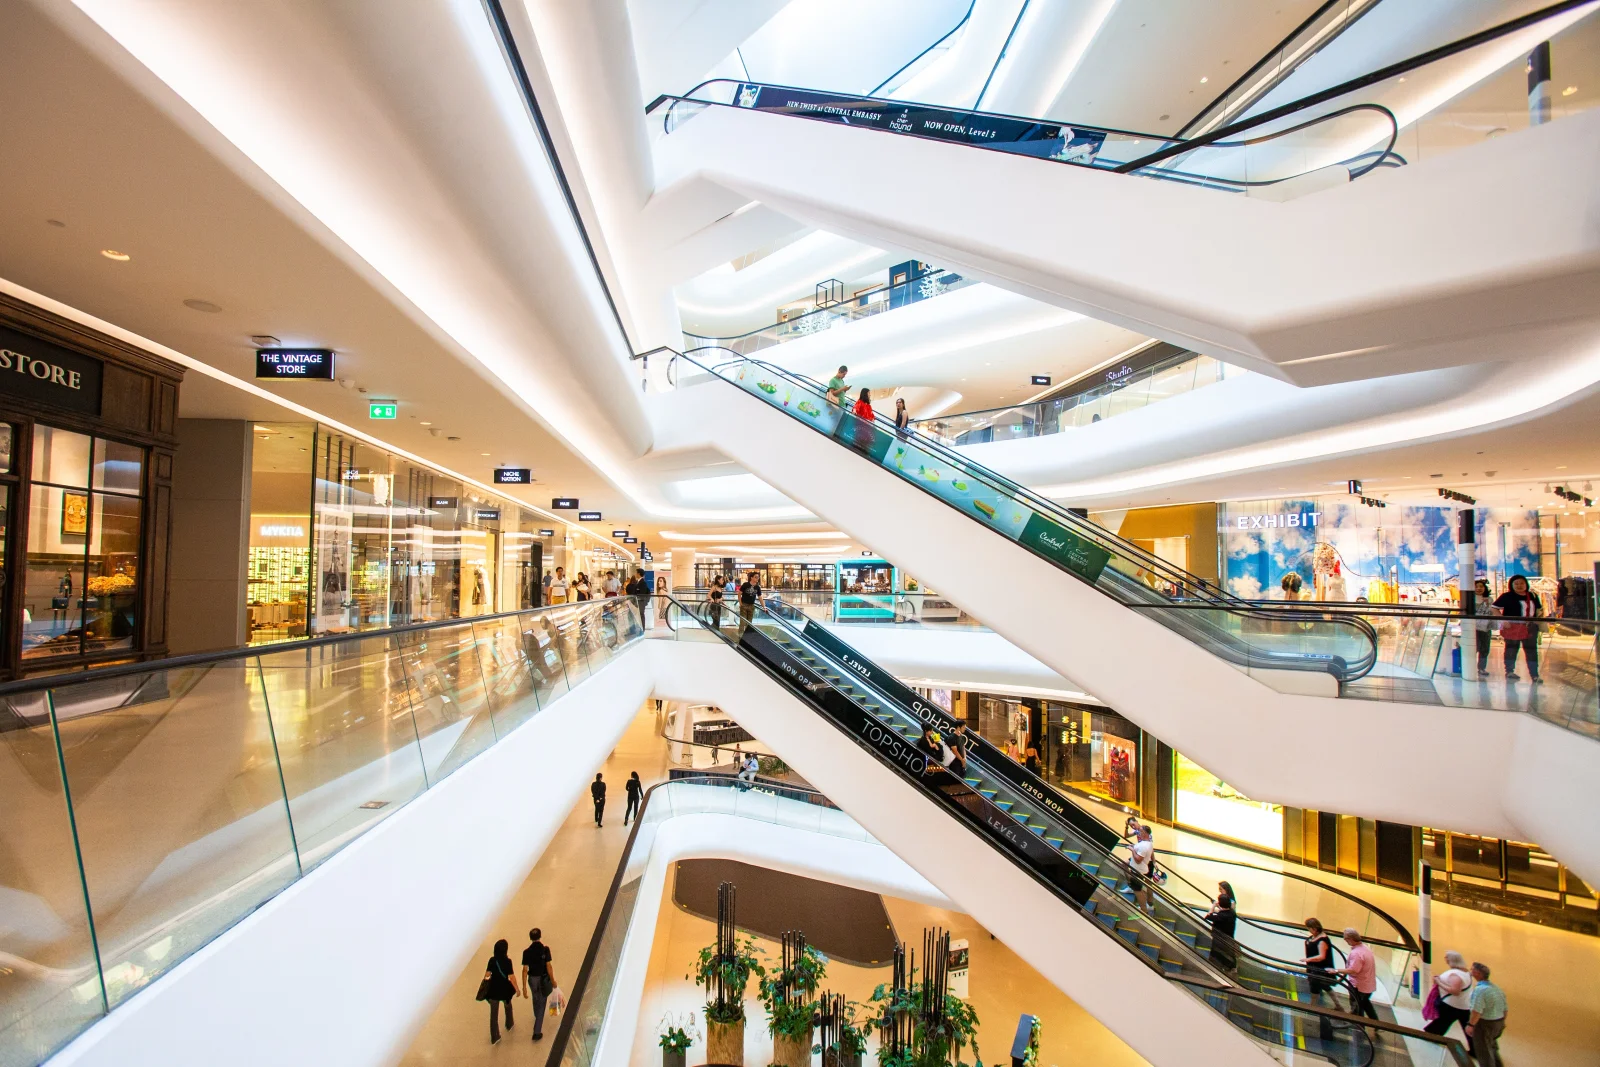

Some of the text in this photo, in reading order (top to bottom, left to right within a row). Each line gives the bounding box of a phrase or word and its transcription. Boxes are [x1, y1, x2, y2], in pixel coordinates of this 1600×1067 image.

[800, 102, 817, 111] TWIST
[824, 106, 851, 116] CENTRAL
[851, 110, 882, 121] EMBASSY
[889, 120, 912, 132] hound
[924, 121, 996, 139] NOW OPEN, Level 5
[261, 354, 323, 363] THE VINTAGE
[0, 349, 81, 390] STORE
[276, 365, 306, 374] STORE
[1237, 512, 1322, 530] EXHIBIT
[1039, 531, 1066, 550] Central
[781, 661, 818, 692] NOW OPEN
[862, 718, 935, 778] TOPSHOP
[987, 816, 1028, 850] LEVEL 3
